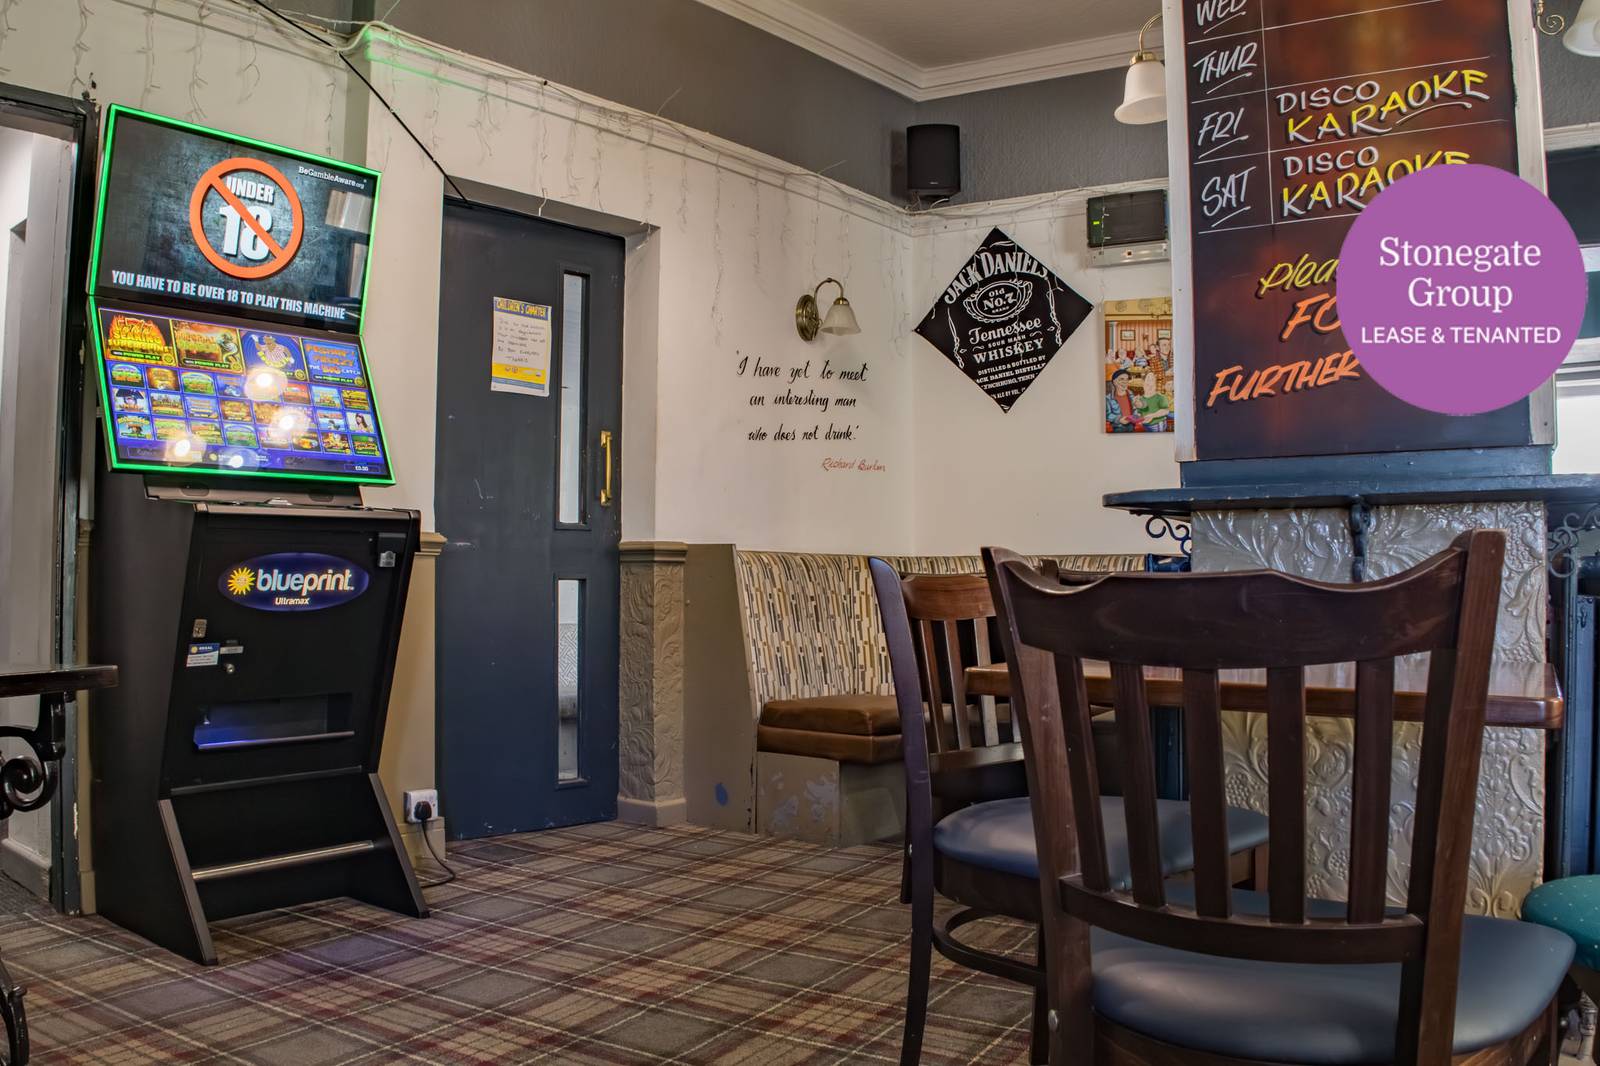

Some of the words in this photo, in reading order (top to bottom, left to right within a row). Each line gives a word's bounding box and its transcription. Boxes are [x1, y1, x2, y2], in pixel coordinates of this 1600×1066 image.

[1197, 0, 1247, 26] WED
[1193, 42, 1258, 84] THUR
[1276, 80, 1380, 114] DISCO
[1287, 69, 1490, 144] KARAOKE
[1198, 107, 1244, 146] FRI
[298, 166, 365, 189] BeGambleAware.org
[1283, 145, 1379, 177] DISCO
[226, 176, 275, 204] UNDER
[1201, 166, 1256, 217] SAT
[218, 204, 273, 261] 18
[944, 262, 984, 304] JACK
[1260, 253, 1340, 294] plea
[112, 270, 134, 286] YOU
[136, 275, 165, 291] HAVE
[166, 279, 181, 293] TO
[182, 281, 196, 296] BE
[198, 284, 224, 300] OVER
[226, 289, 238, 303] 18
[240, 291, 254, 305] TO
[254, 293, 279, 309] PLAY
[280, 297, 302, 312] THIS
[303, 301, 345, 320] MACHINE
[969, 318, 1042, 344] Tennessee
[1282, 293, 1341, 339] FO
[973, 338, 1044, 365] WHISKEY
[753, 357, 781, 377] have
[787, 360, 810, 384] yet
[820, 359, 833, 379] to
[839, 362, 868, 382] meet
[1207, 349, 1360, 407] FURTHER
[749, 395, 765, 406] an
[774, 389, 829, 412] interesting
[834, 396, 857, 407] man
[748, 427, 767, 441] who
[773, 424, 796, 441] does
[802, 425, 819, 440] not
[822, 457, 856, 472] Richard
[275, 597, 310, 605] Ultramax
